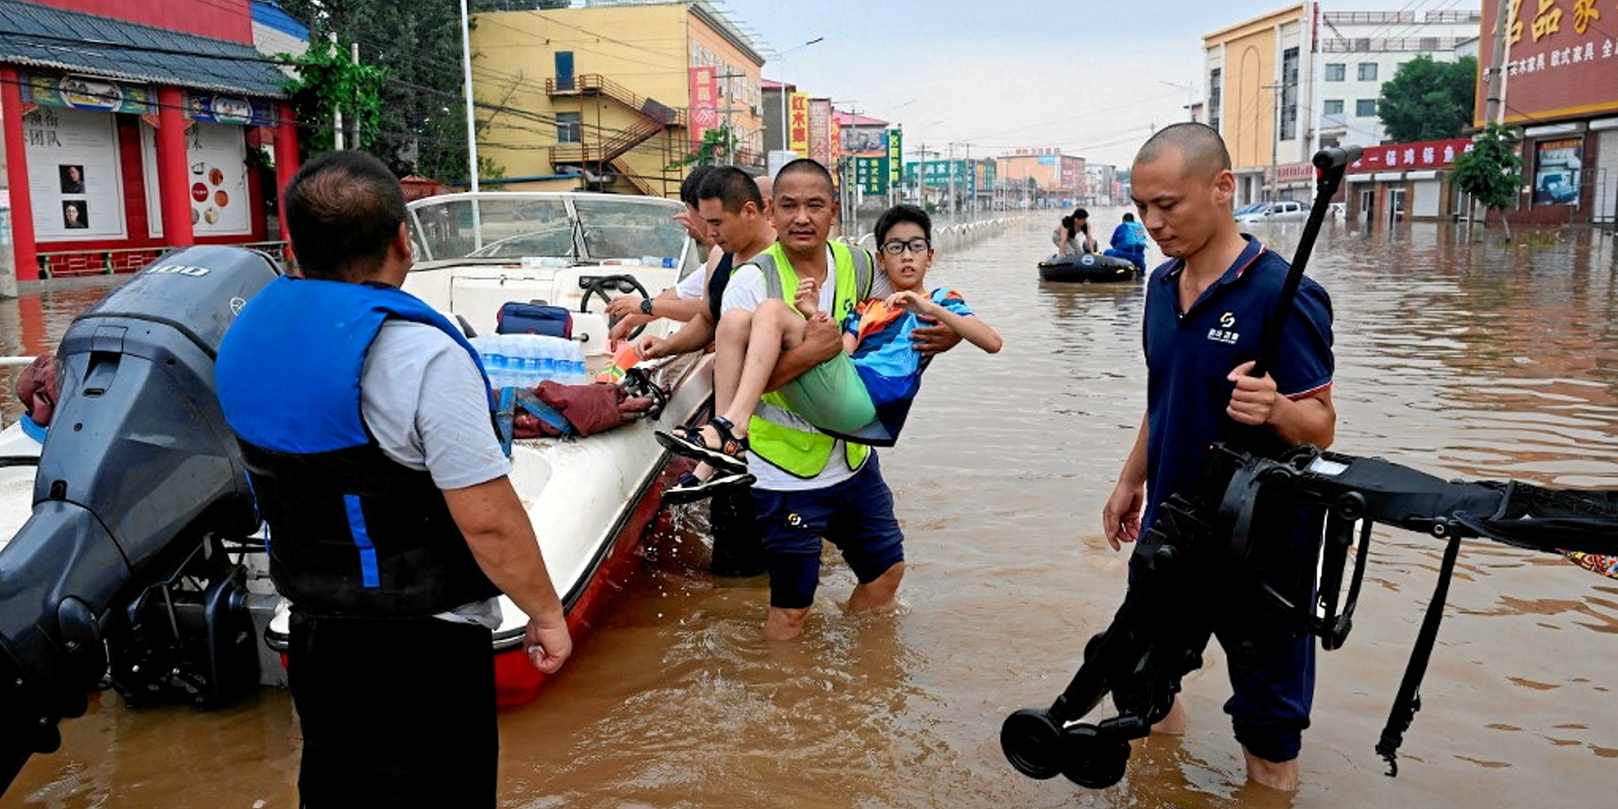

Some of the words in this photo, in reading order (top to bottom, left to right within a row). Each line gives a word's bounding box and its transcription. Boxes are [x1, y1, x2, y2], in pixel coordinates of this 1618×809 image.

[1492, 0, 1618, 45] 名品家
[1550, 42, 1594, 67] 欧式家具
[1602, 36, 1618, 58] 全
[22, 105, 58, 128] 领衔
[24, 129, 61, 147] 团队
